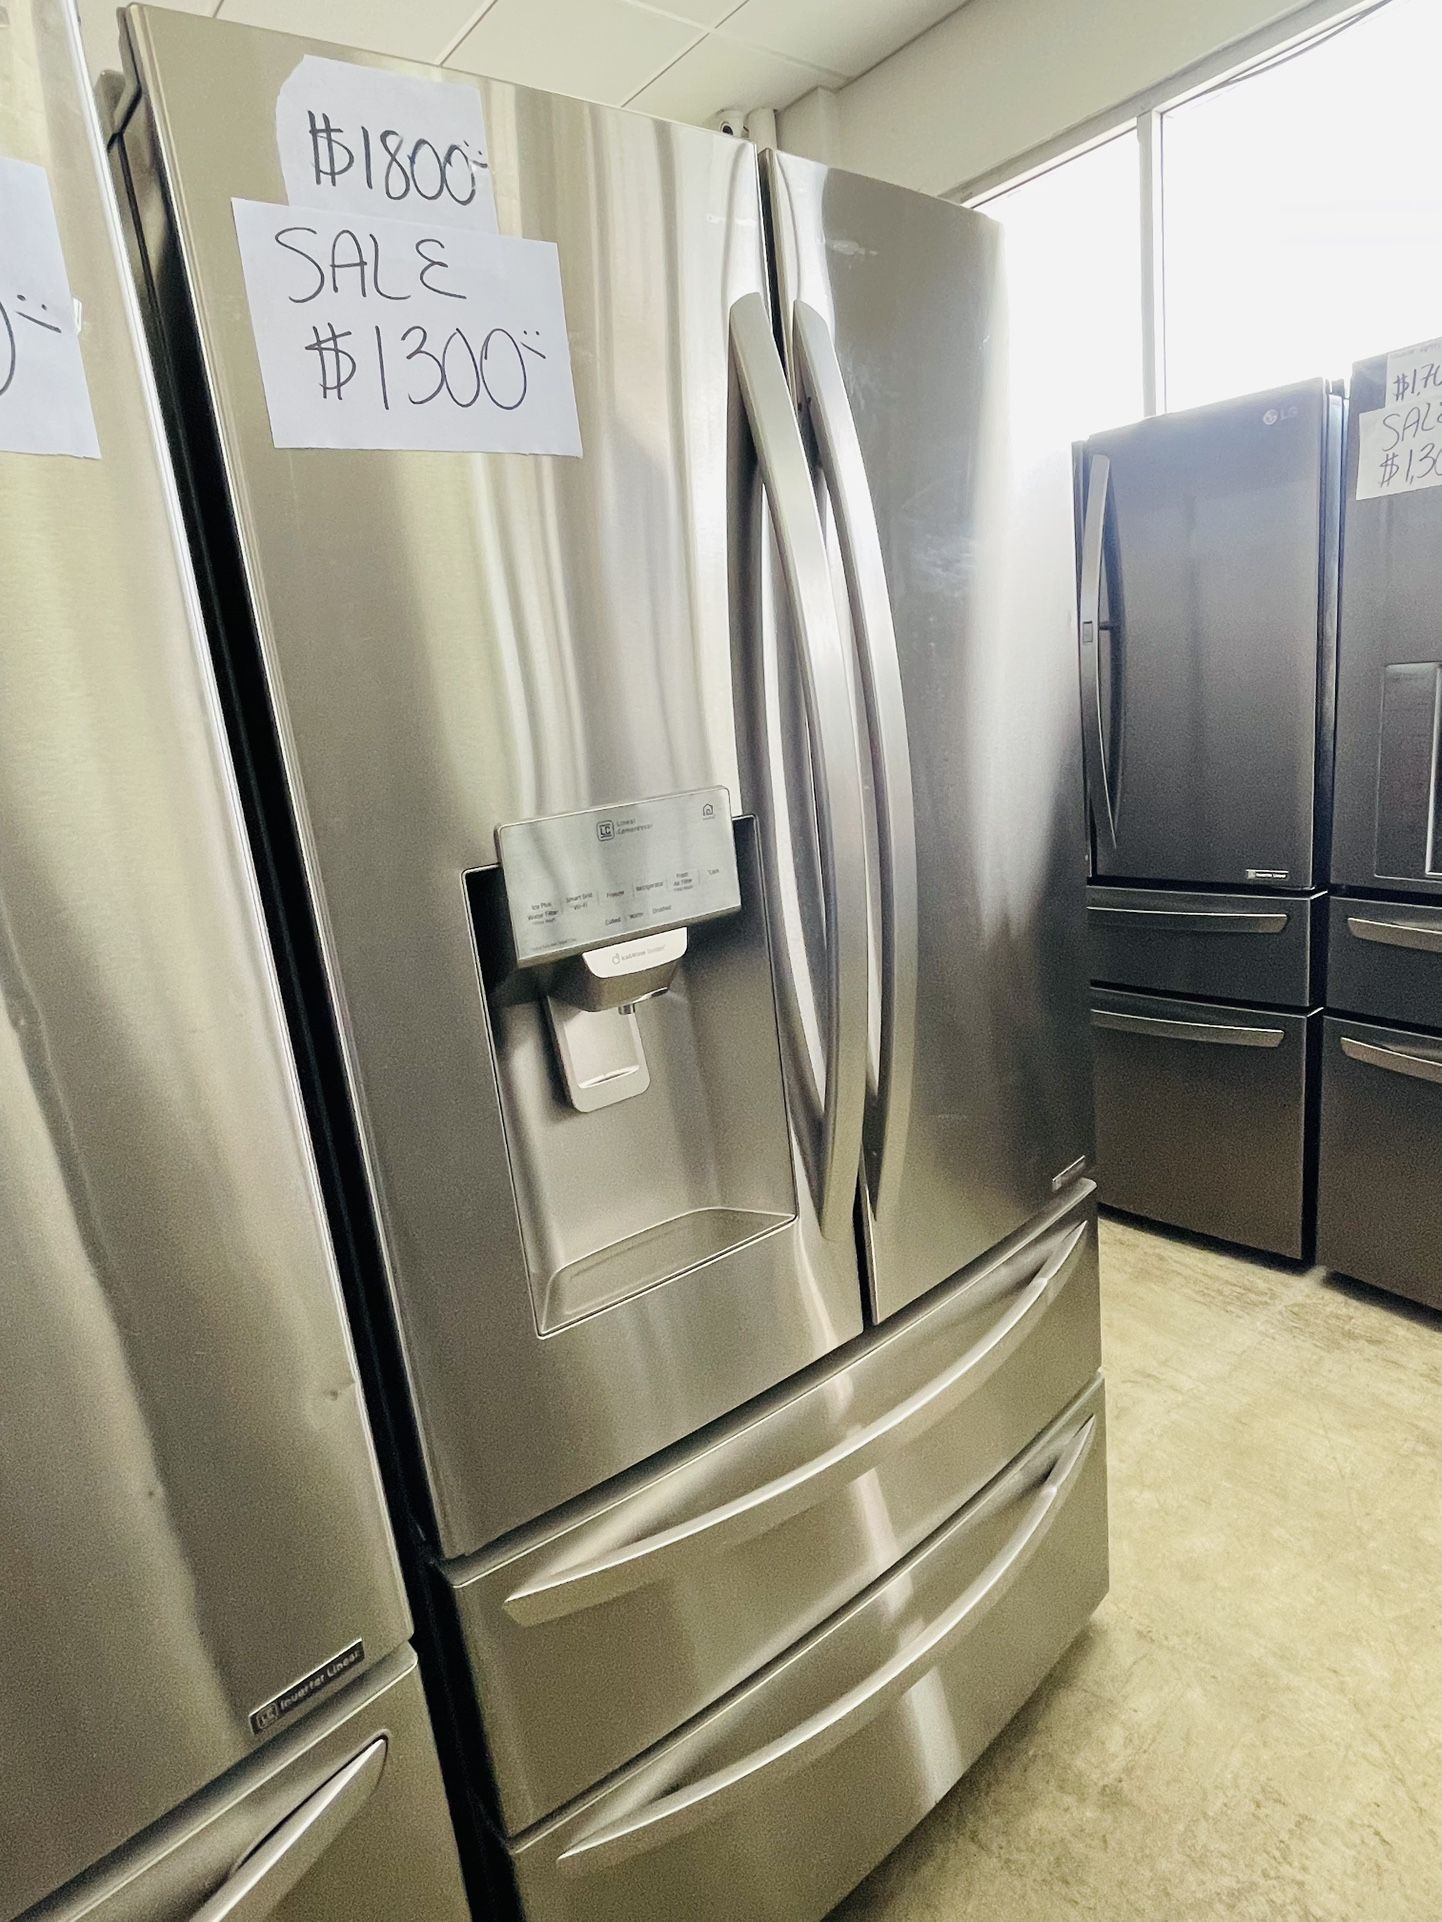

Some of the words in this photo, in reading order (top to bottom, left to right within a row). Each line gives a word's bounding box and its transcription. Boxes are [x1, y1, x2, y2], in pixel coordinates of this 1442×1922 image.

[275, 226, 467, 303] SALE
[280, 1674, 325, 1711] Inverter
[326, 1650, 360, 1678] Linear
